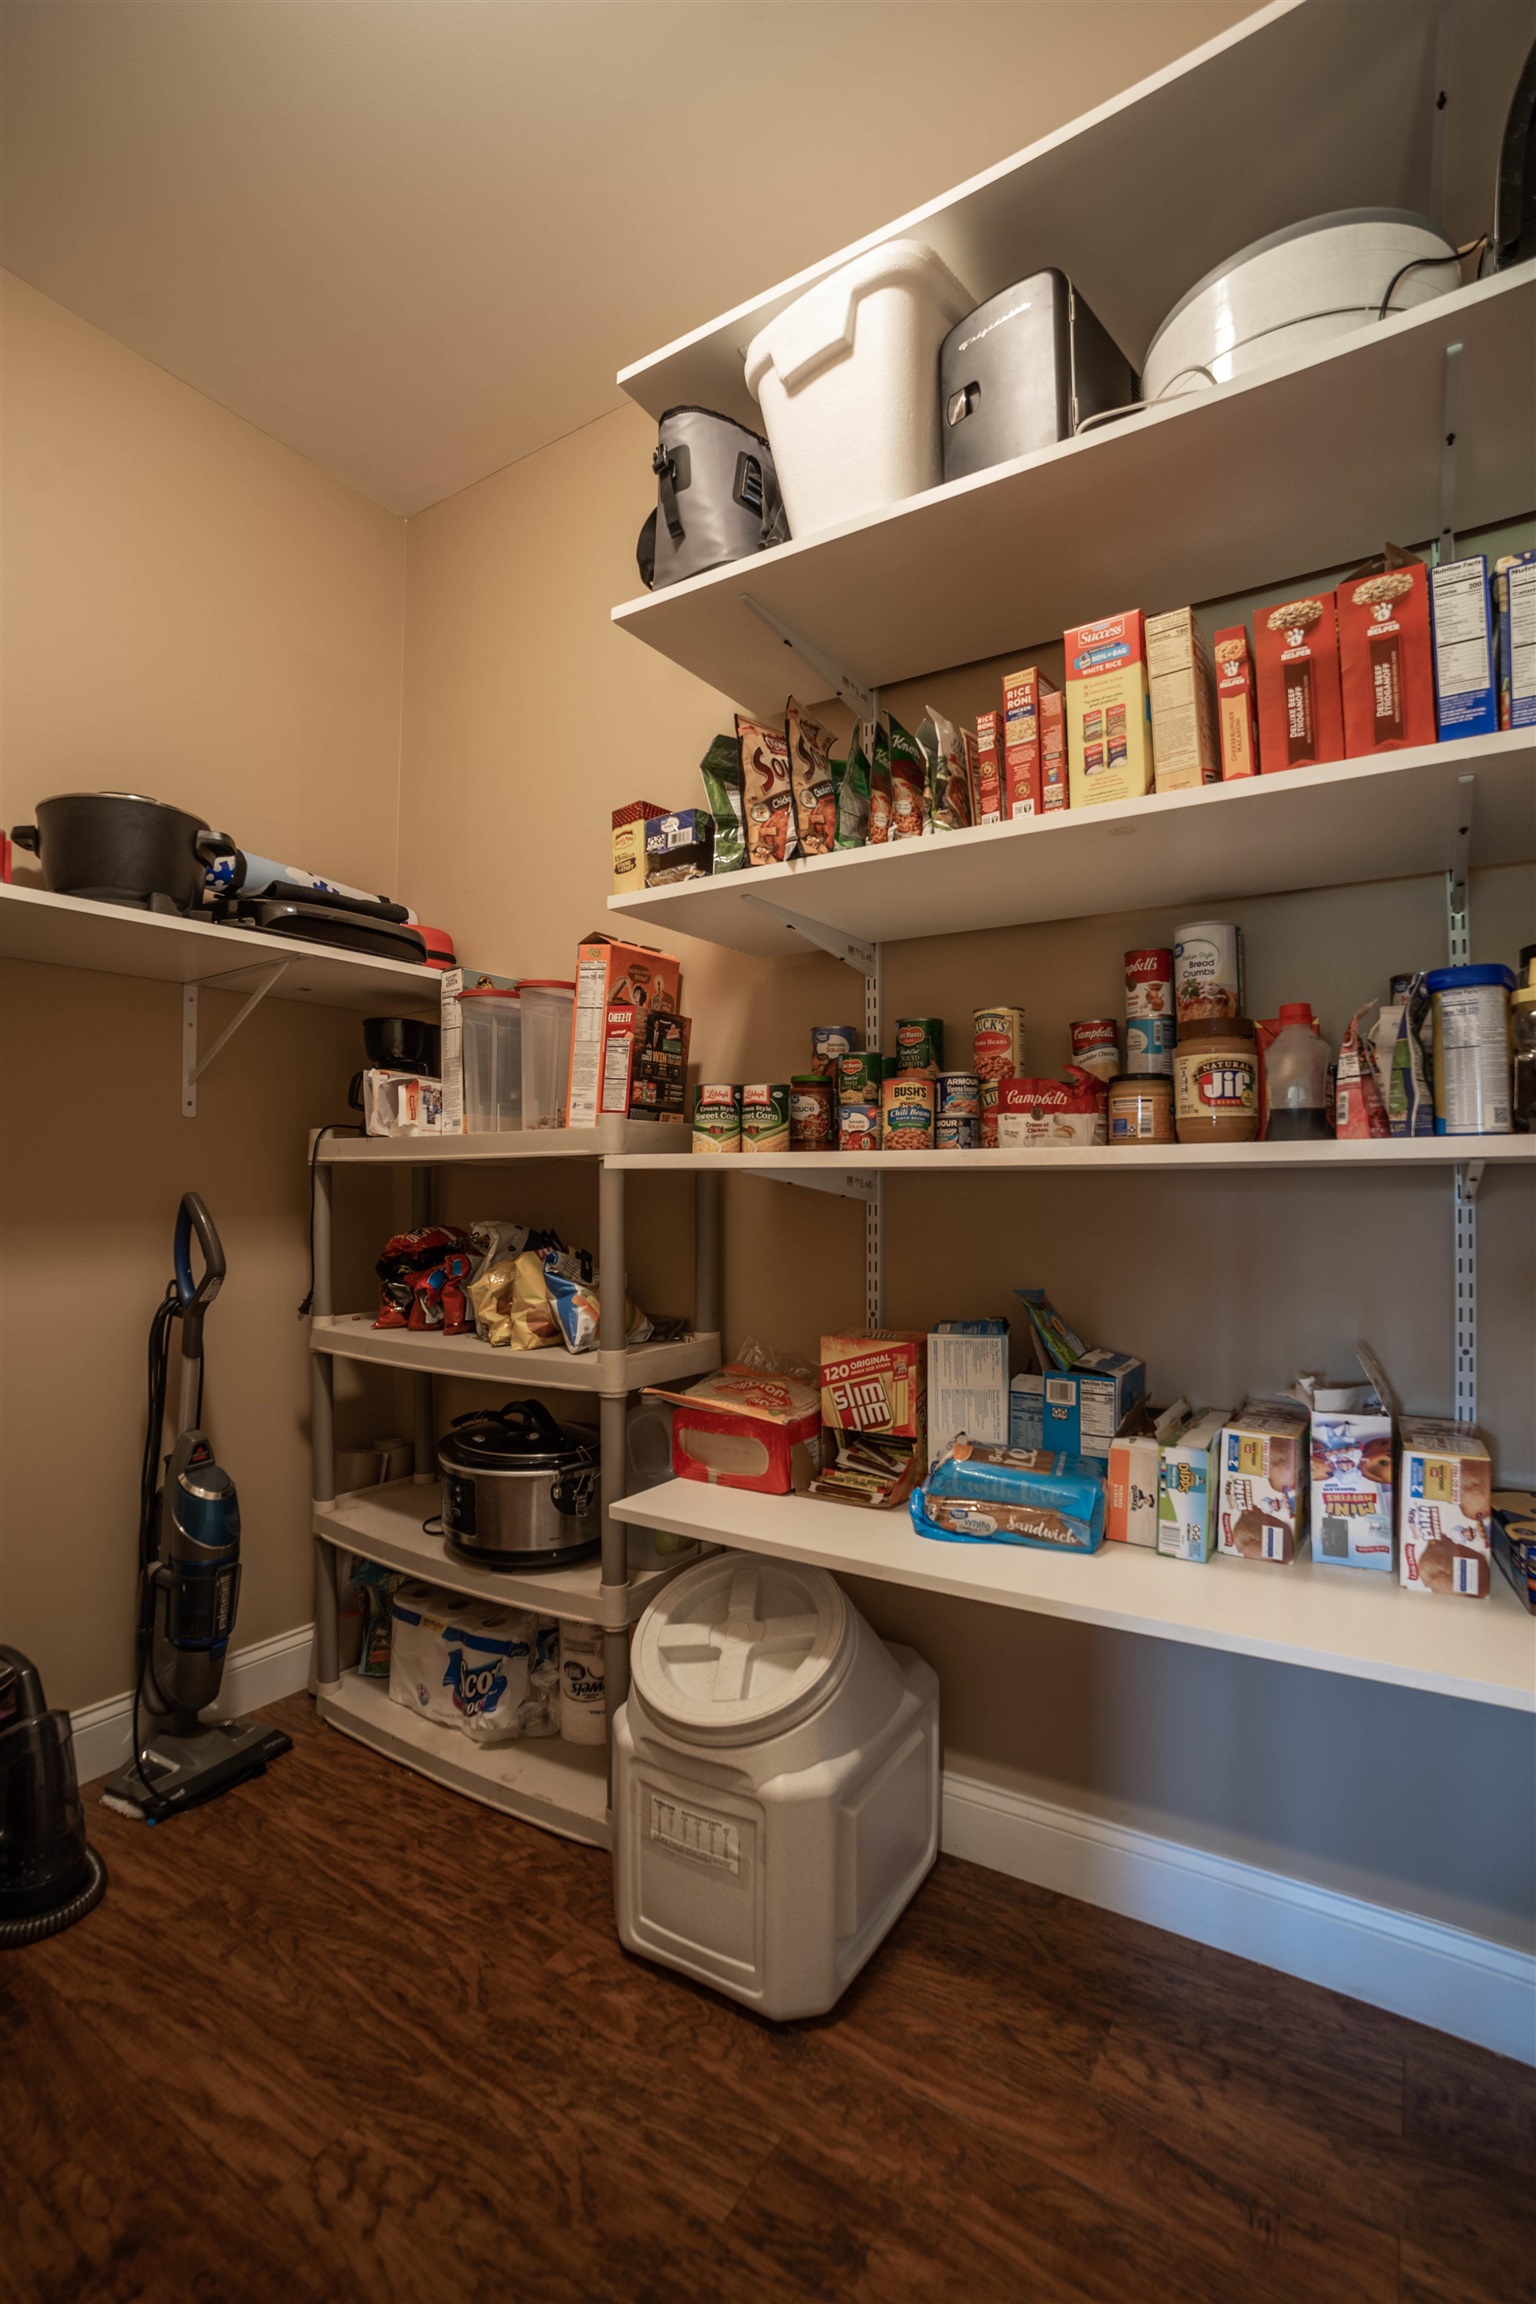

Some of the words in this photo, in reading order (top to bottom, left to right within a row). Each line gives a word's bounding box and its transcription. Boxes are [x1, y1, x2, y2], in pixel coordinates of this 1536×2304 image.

[1433, 564, 1462, 576] Nutrition
[1463, 559, 1482, 569] Facts
[1468, 581, 1483, 590] 200
[1080, 625, 1123, 646] Success
[1367, 622, 1400, 637] HELPER
[1112, 647, 1128, 657] BAG
[1281, 648, 1312, 662] HELPER
[1082, 664, 1104, 676] WHITE
[1105, 659, 1122, 669] RICE
[1374, 665, 1382, 686] BEEF
[1006, 685, 1031, 700] RICE
[1382, 663, 1393, 716] STROGANOFF
[1376, 688, 1384, 717] DELUXE
[1295, 686, 1305, 737] STROGANOFF
[977, 715, 994, 724] RICE
[1289, 709, 1297, 739] DELUXE
[1189, 959, 1215, 969] Bread
[1183, 968, 1215, 979] Crumbs
[906, 1030, 923, 1039] Monte
[1073, 1023, 1115, 1042] Campbell's
[652, 1050, 667, 1063] WIN
[900, 1054, 920, 1062] SLICED
[1098, 1049, 1116, 1059] Cheese
[1203, 1060, 1251, 1072] NATURAL
[1203, 1071, 1251, 1099] Jif
[706, 1088, 729, 1100] Libby's
[744, 1088, 765, 1100] Libby's
[893, 1087, 928, 1099] BUSH'S
[1006, 1089, 1068, 1107] Campbell's
[700, 1105, 719, 1113] Cream
[719, 1105, 735, 1114] Style
[755, 1104, 772, 1113] Style
[790, 1105, 816, 1114] Sauce
[890, 1107, 908, 1118] Chili
[909, 1108, 931, 1119] Beans
[695, 1112, 718, 1121] Sweet
[720, 1111, 739, 1121] Corn
[756, 1111, 778, 1121] Corn
[823, 1364, 849, 1382] 120
[850, 1353, 891, 1371] ORIGINAL
[850, 1368, 866, 1376] SNACK
[875, 1362, 892, 1371] STICKS
[1081, 1379, 1101, 1387] Nutrition
[1101, 1381, 1115, 1389] Facts
[1228, 1459, 1238, 1469] 2
[1177, 1462, 1192, 1495] DIPPS
[1234, 1478, 1248, 1511] MINI
[1244, 1480, 1254, 1511] MUFFINS
[1411, 1484, 1423, 1493] 2
[1130, 1484, 1139, 1512] QUAKER
[1325, 1494, 1374, 1502] MUFFINS
[1325, 1502, 1376, 1519] MINI
[1006, 1515, 1078, 1544] Sandwich
[1418, 1505, 1435, 1541] MINI
[1431, 1506, 1441, 1540] MUFFINS
